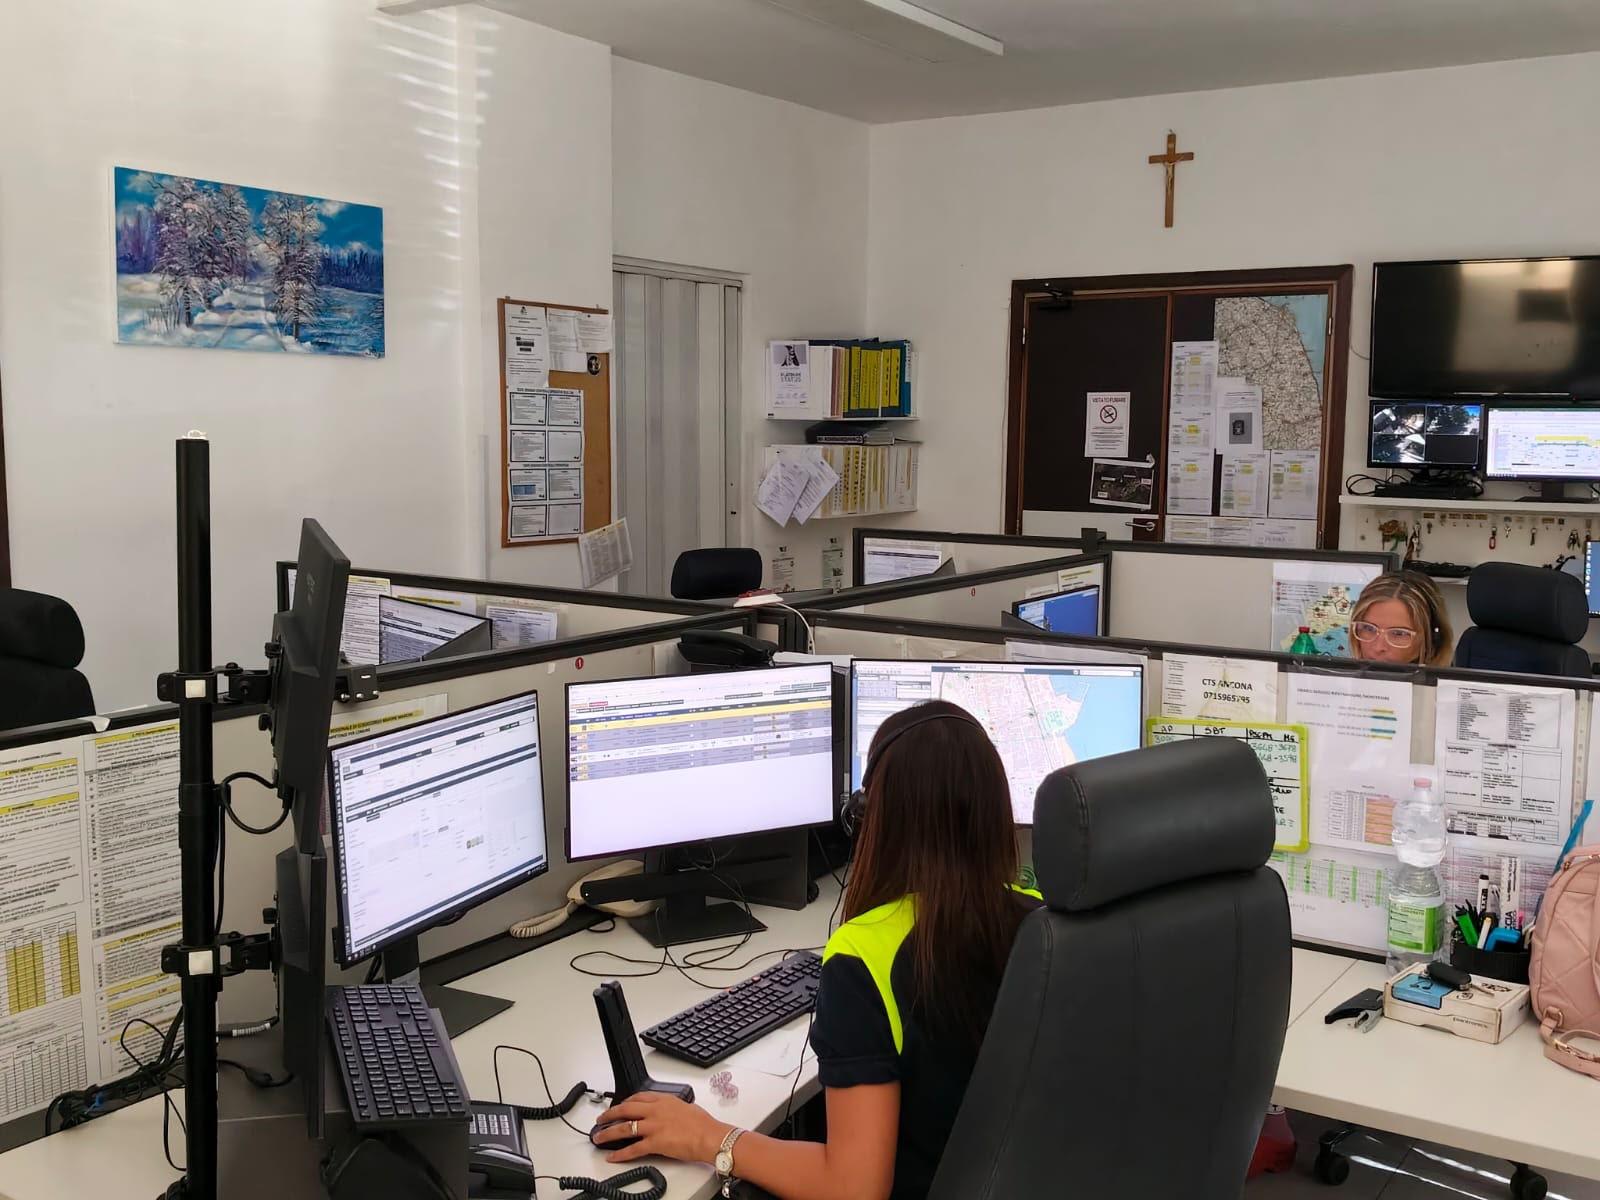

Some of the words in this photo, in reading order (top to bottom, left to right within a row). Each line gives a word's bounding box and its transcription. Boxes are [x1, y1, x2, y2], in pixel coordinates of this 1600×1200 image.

[1202, 678, 1216, 687] CTS
[1217, 679, 1253, 691] ANCONA
[1204, 727, 1226, 735] SBT
